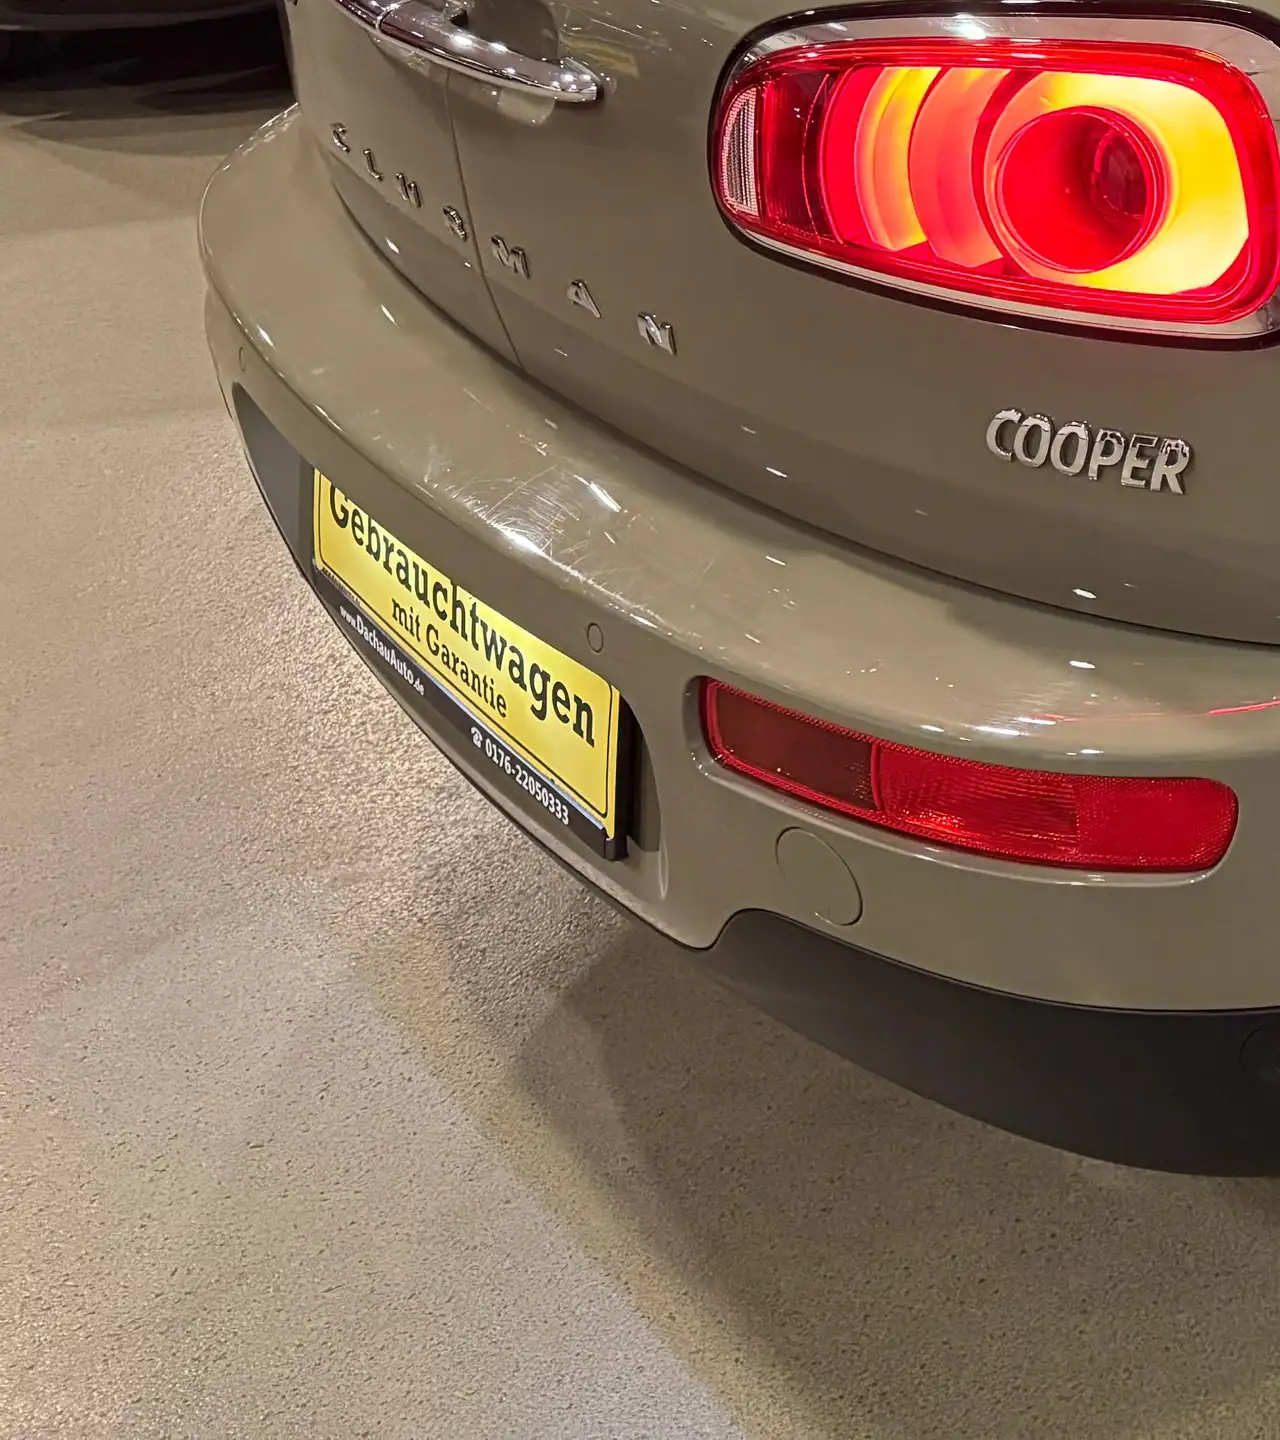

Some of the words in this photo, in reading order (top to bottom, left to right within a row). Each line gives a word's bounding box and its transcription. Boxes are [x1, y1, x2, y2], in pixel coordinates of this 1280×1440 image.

[986, 408, 1192, 495] COOPER
[329, 483, 595, 748] Gebrauchtwagen
[340, 605, 425, 696] www.DachauAuto.de
[392, 598, 420, 644] mit
[426, 623, 507, 718] Garantie
[485, 741, 569, 826] 0176-22050333
